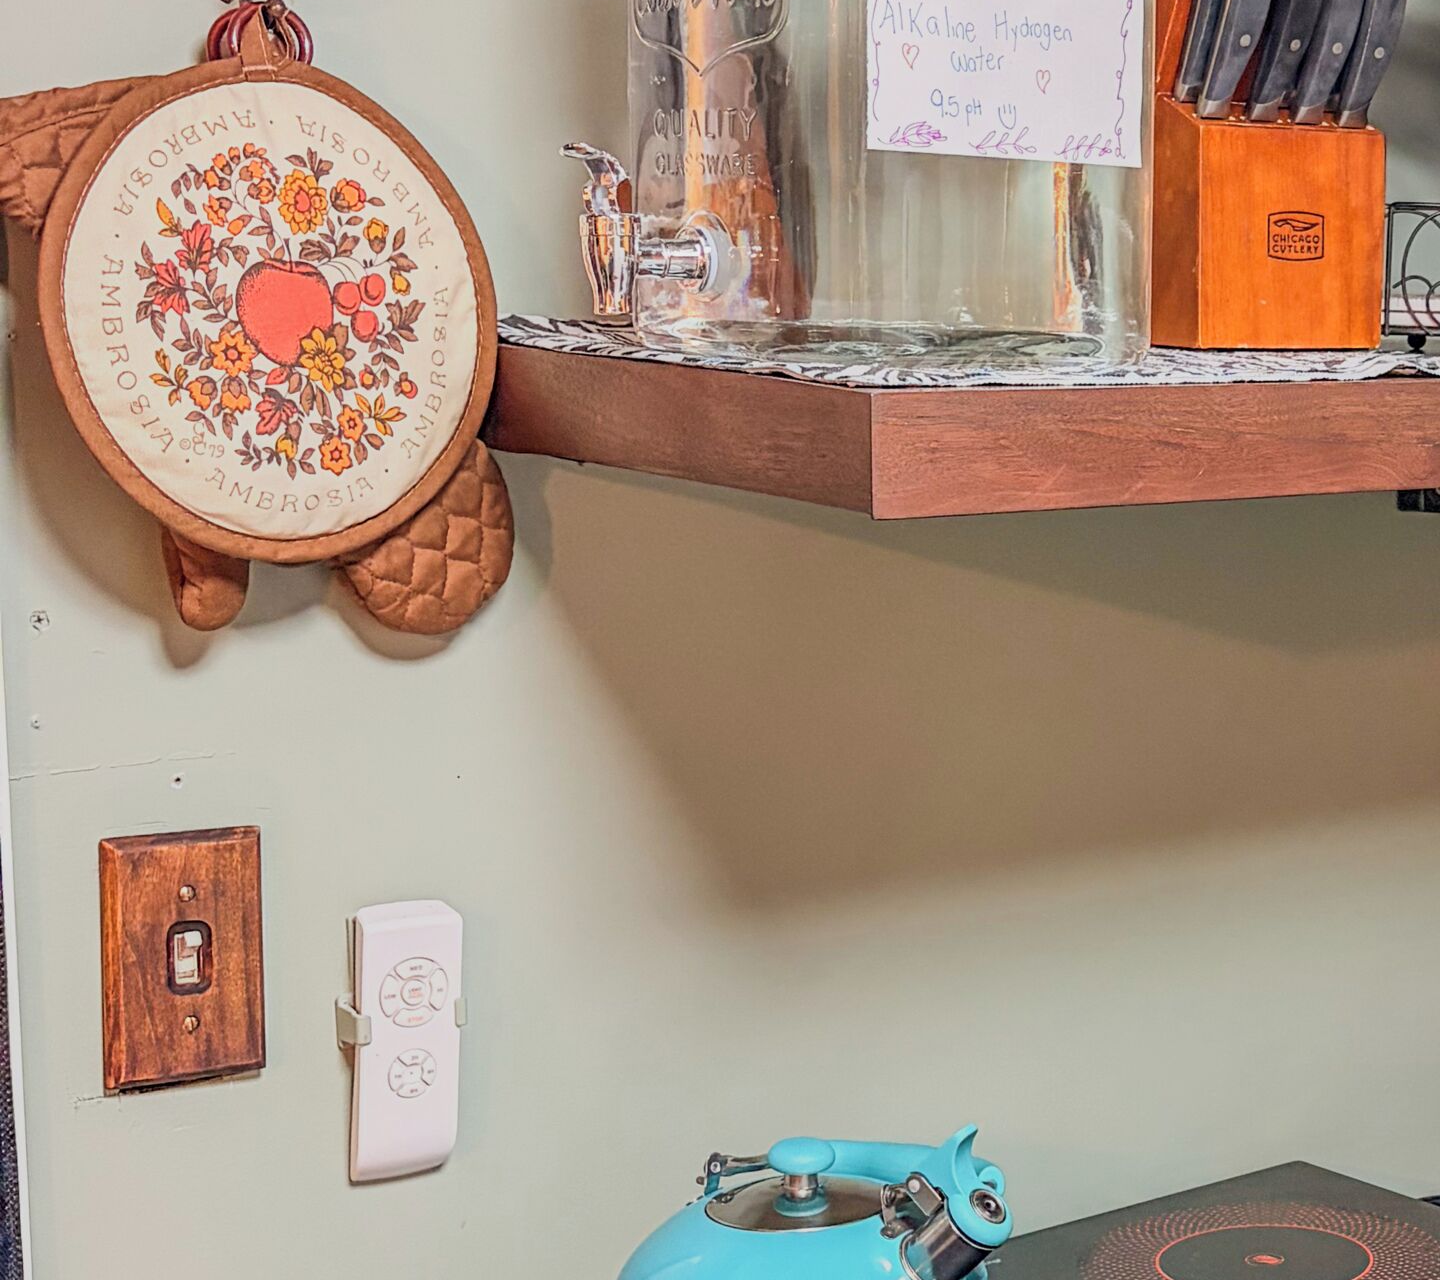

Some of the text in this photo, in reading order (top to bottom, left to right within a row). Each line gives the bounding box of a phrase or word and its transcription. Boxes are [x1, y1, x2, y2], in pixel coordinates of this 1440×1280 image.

[994, 9, 1073, 52] Hydrogen
[653, 107, 757, 141] QUALITY
[930, 88, 982, 127] 9.5 pH
[113, 109, 257, 218] AMBROSIA
[296, 114, 435, 249] AMBROSIA
[655, 152, 760, 177] GLASSWARE
[1272, 233, 1320, 244] CHICAGO
[1272, 244, 1320, 254] CUTLERY
[100, 254, 173, 453] AMBROSIA
[399, 286, 450, 459] AMBROSIA
[204, 466, 375, 513] AMBROSIA
